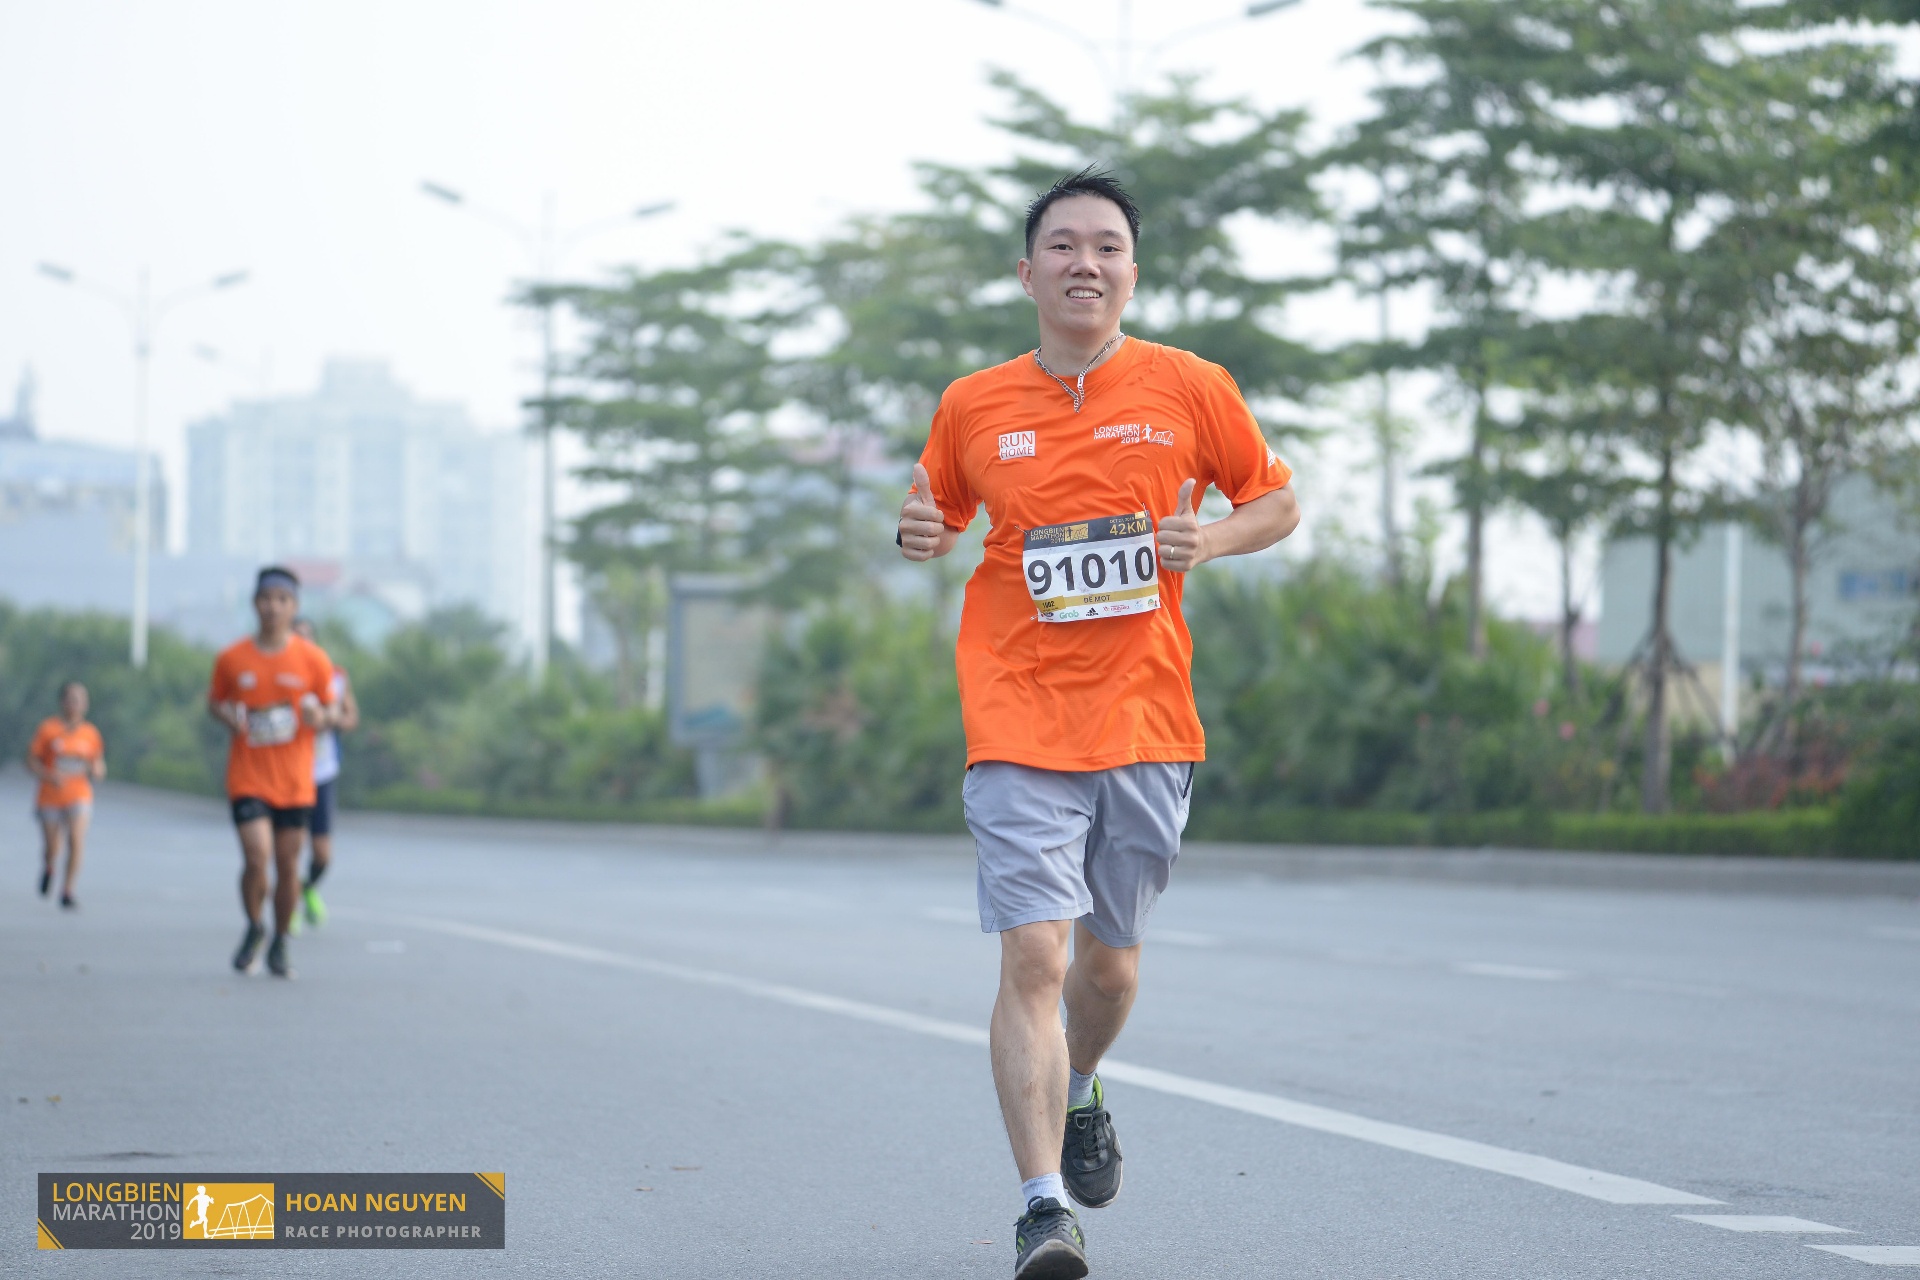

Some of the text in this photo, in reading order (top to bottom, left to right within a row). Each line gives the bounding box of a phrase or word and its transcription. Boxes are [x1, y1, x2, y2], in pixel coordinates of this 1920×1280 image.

[1094, 424, 1140, 435] LONGBIEN
[1093, 430, 1140, 440] MARATHON
[1121, 436, 1140, 444] 2019
[1000, 433, 1033, 448] RUN
[1001, 446, 1033, 459] HOME
[1030, 527, 1064, 537] LONGBIEN
[1109, 519, 1147, 536] 42KM
[1030, 532, 1065, 541] MARATHON
[1027, 546, 1154, 595] 91010
[1059, 610, 1080, 619] Grab
